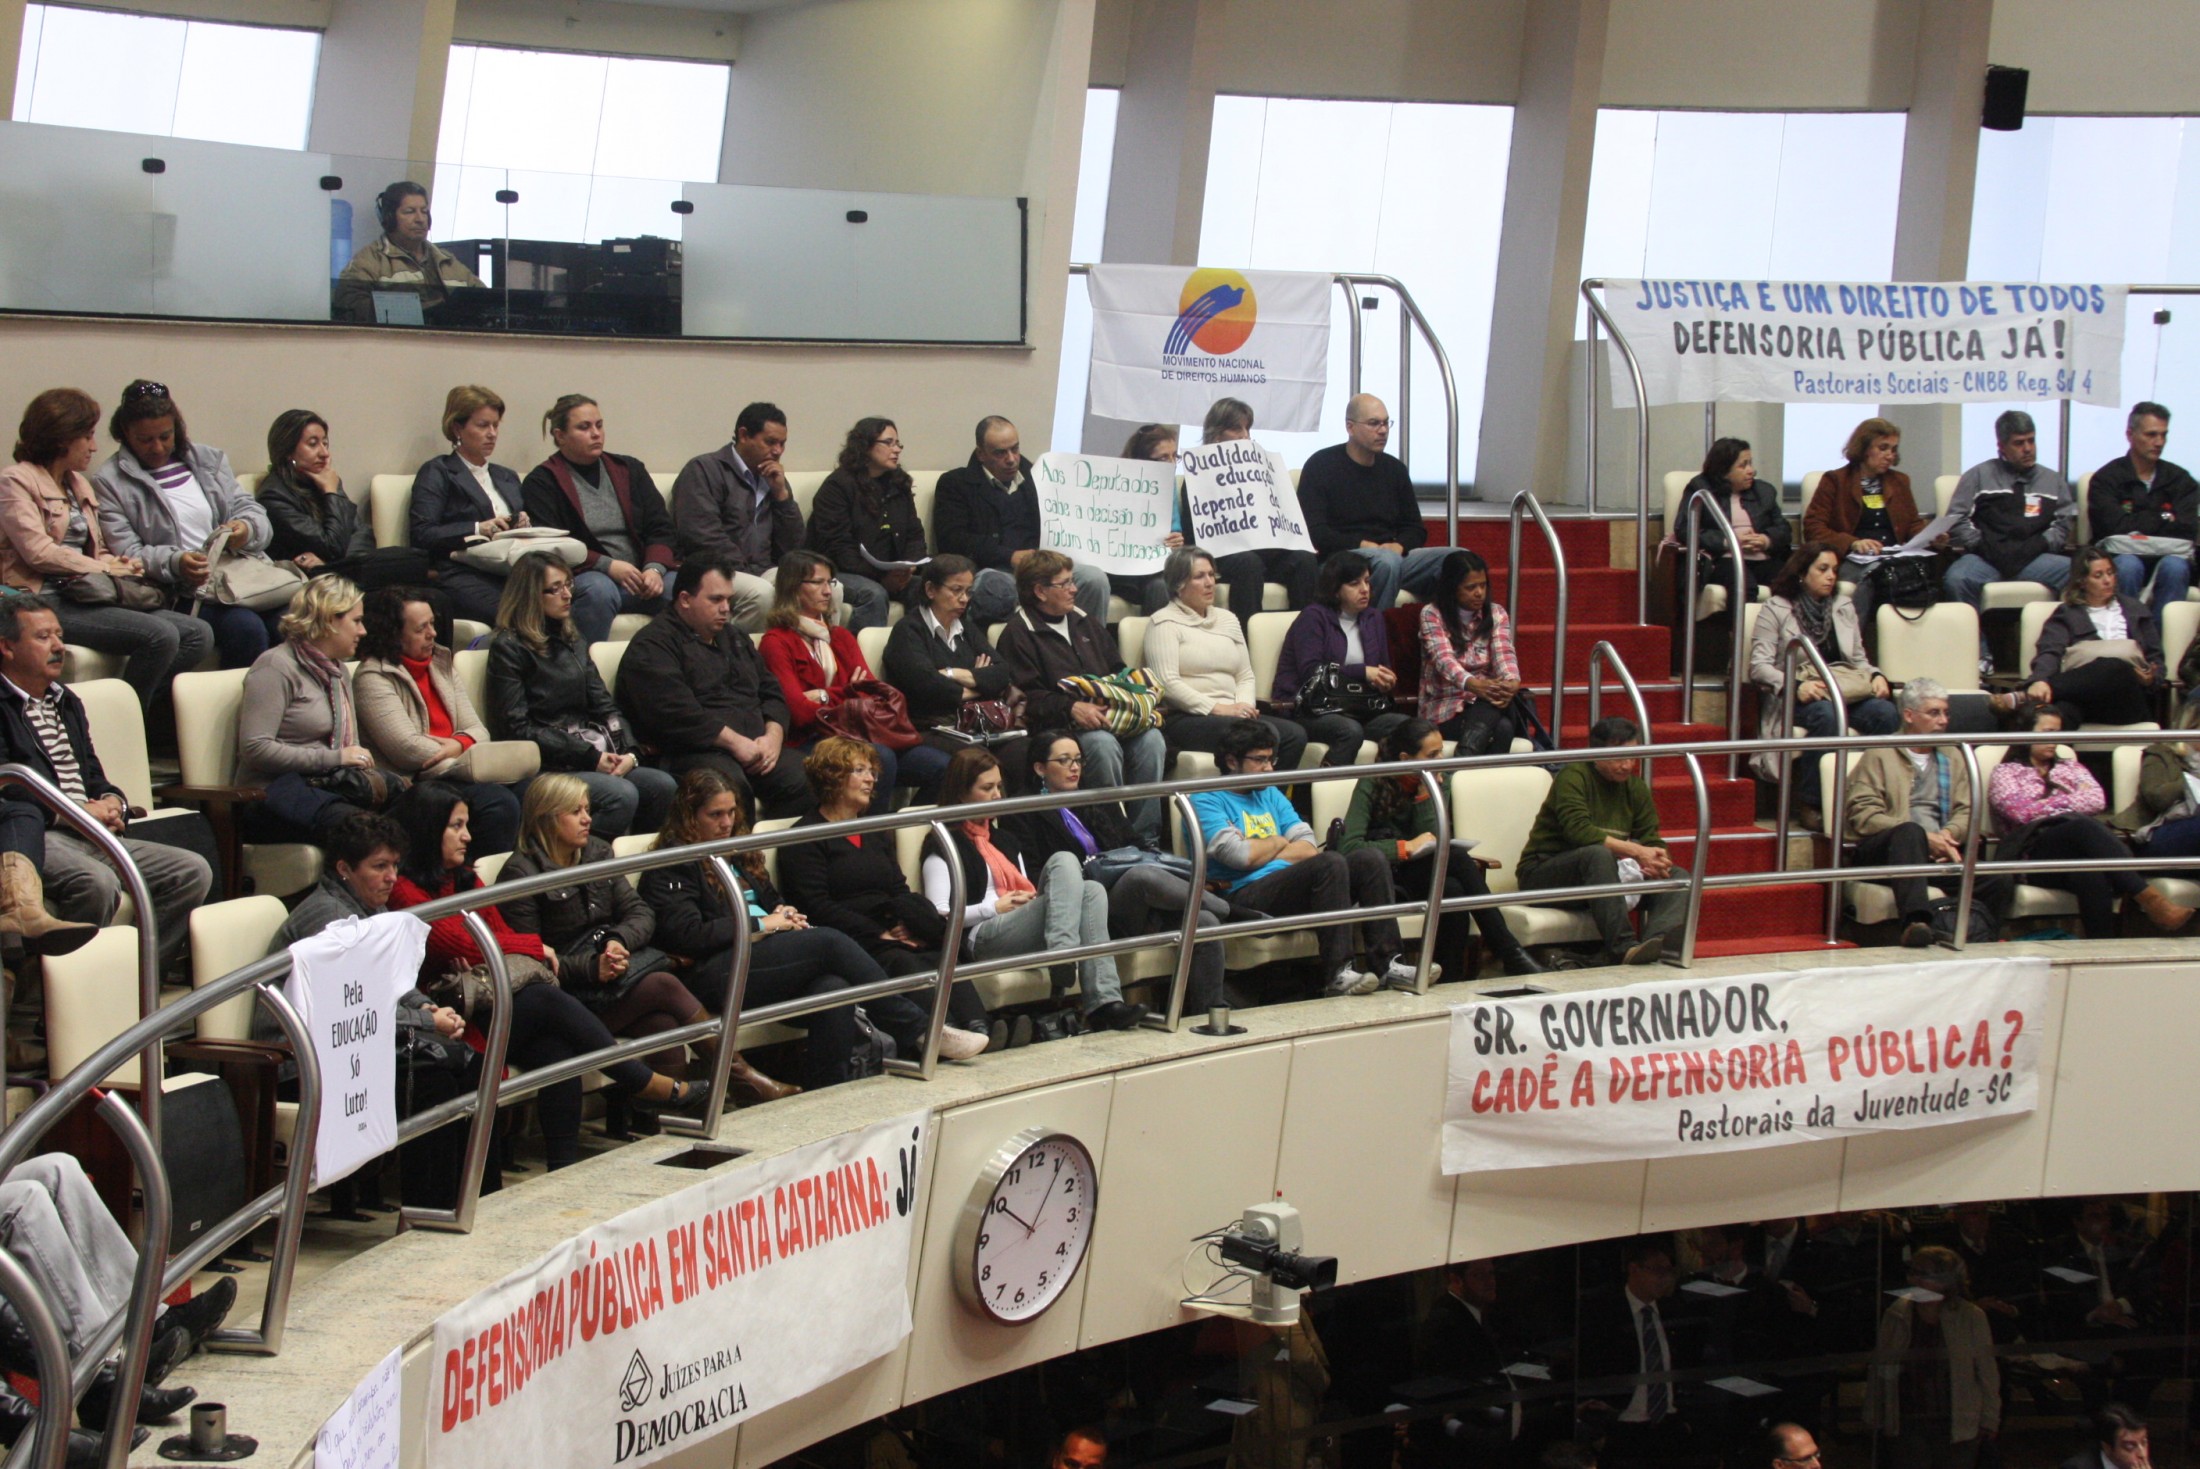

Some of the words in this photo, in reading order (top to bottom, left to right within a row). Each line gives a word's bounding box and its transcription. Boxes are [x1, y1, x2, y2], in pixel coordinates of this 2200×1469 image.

[1636, 280, 1750, 312] JUSTIÇA
[1782, 283, 1833, 315] UM
[1839, 284, 1950, 319] DIREITO
[1959, 285, 1998, 316] DE
[2004, 284, 2105, 314] TODOS
[1673, 320, 1846, 361] DEFENSORIA
[1857, 322, 1986, 362] PÚBLICA
[2001, 318, 2067, 360] JÁ!
[1162, 355, 1217, 368] MOVIMENTO
[1218, 358, 1265, 370] NACIONAL
[1161, 370, 1175, 380] DE
[1176, 371, 1218, 383] DIREITOS
[1220, 373, 1267, 384] HUMANOS
[1794, 370, 1882, 395] Pastorais
[1887, 371, 1950, 395] Sociais
[2017, 370, 2053, 396] Reg.
[2082, 369, 2094, 395] 4
[1183, 440, 1263, 476] Qualidade
[1041, 458, 1066, 486] Aos
[1074, 459, 1160, 496] Deputados
[1044, 488, 1071, 518] cabe
[1074, 503, 1083, 520] a
[1086, 494, 1134, 526] decisão
[1139, 499, 1157, 528] do
[1192, 487, 1256, 520] depende
[1044, 518, 1082, 550] Futuro
[1086, 527, 1101, 554] da
[1196, 510, 1259, 540] vontade
[343, 980, 364, 1007] Pela
[331, 1008, 378, 1049] EDUCAÇÃO
[1474, 1005, 1528, 1055] SR.
[1540, 983, 1789, 1052] GOVERNADOR,
[350, 1053, 361, 1080] Só
[1471, 1053, 1560, 1114] CADÊ
[1570, 1060, 1596, 1108] A
[1608, 1039, 1807, 1104] DEFENSORIA
[1828, 1009, 2024, 1082] PÚBLICA?
[344, 1087, 368, 1118] Luto!
[1678, 1098, 1793, 1142] Pastorais
[1807, 1094, 1835, 1128] da
[1854, 1077, 1970, 1122] Juventude
[1029, 1151, 1045, 1169] 12
[1008, 1168, 1021, 1186] 11
[1064, 1177, 1075, 1194] 2
[989, 1196, 1007, 1215] 10
[1066, 1207, 1077, 1223] 3
[979, 1233, 990, 1250] 9
[1055, 1241, 1066, 1256] 4
[981, 1264, 991, 1281] 8
[1037, 1270, 1048, 1287] 5
[996, 1283, 1007, 1301] 7
[1013, 1287, 1025, 1303] 6
[441, 1277, 565, 1433] DEFENSORIA
[567, 1239, 664, 1350] PÚBLICA
[667, 1220, 700, 1305] EM
[703, 1194, 772, 1291] SANTA
